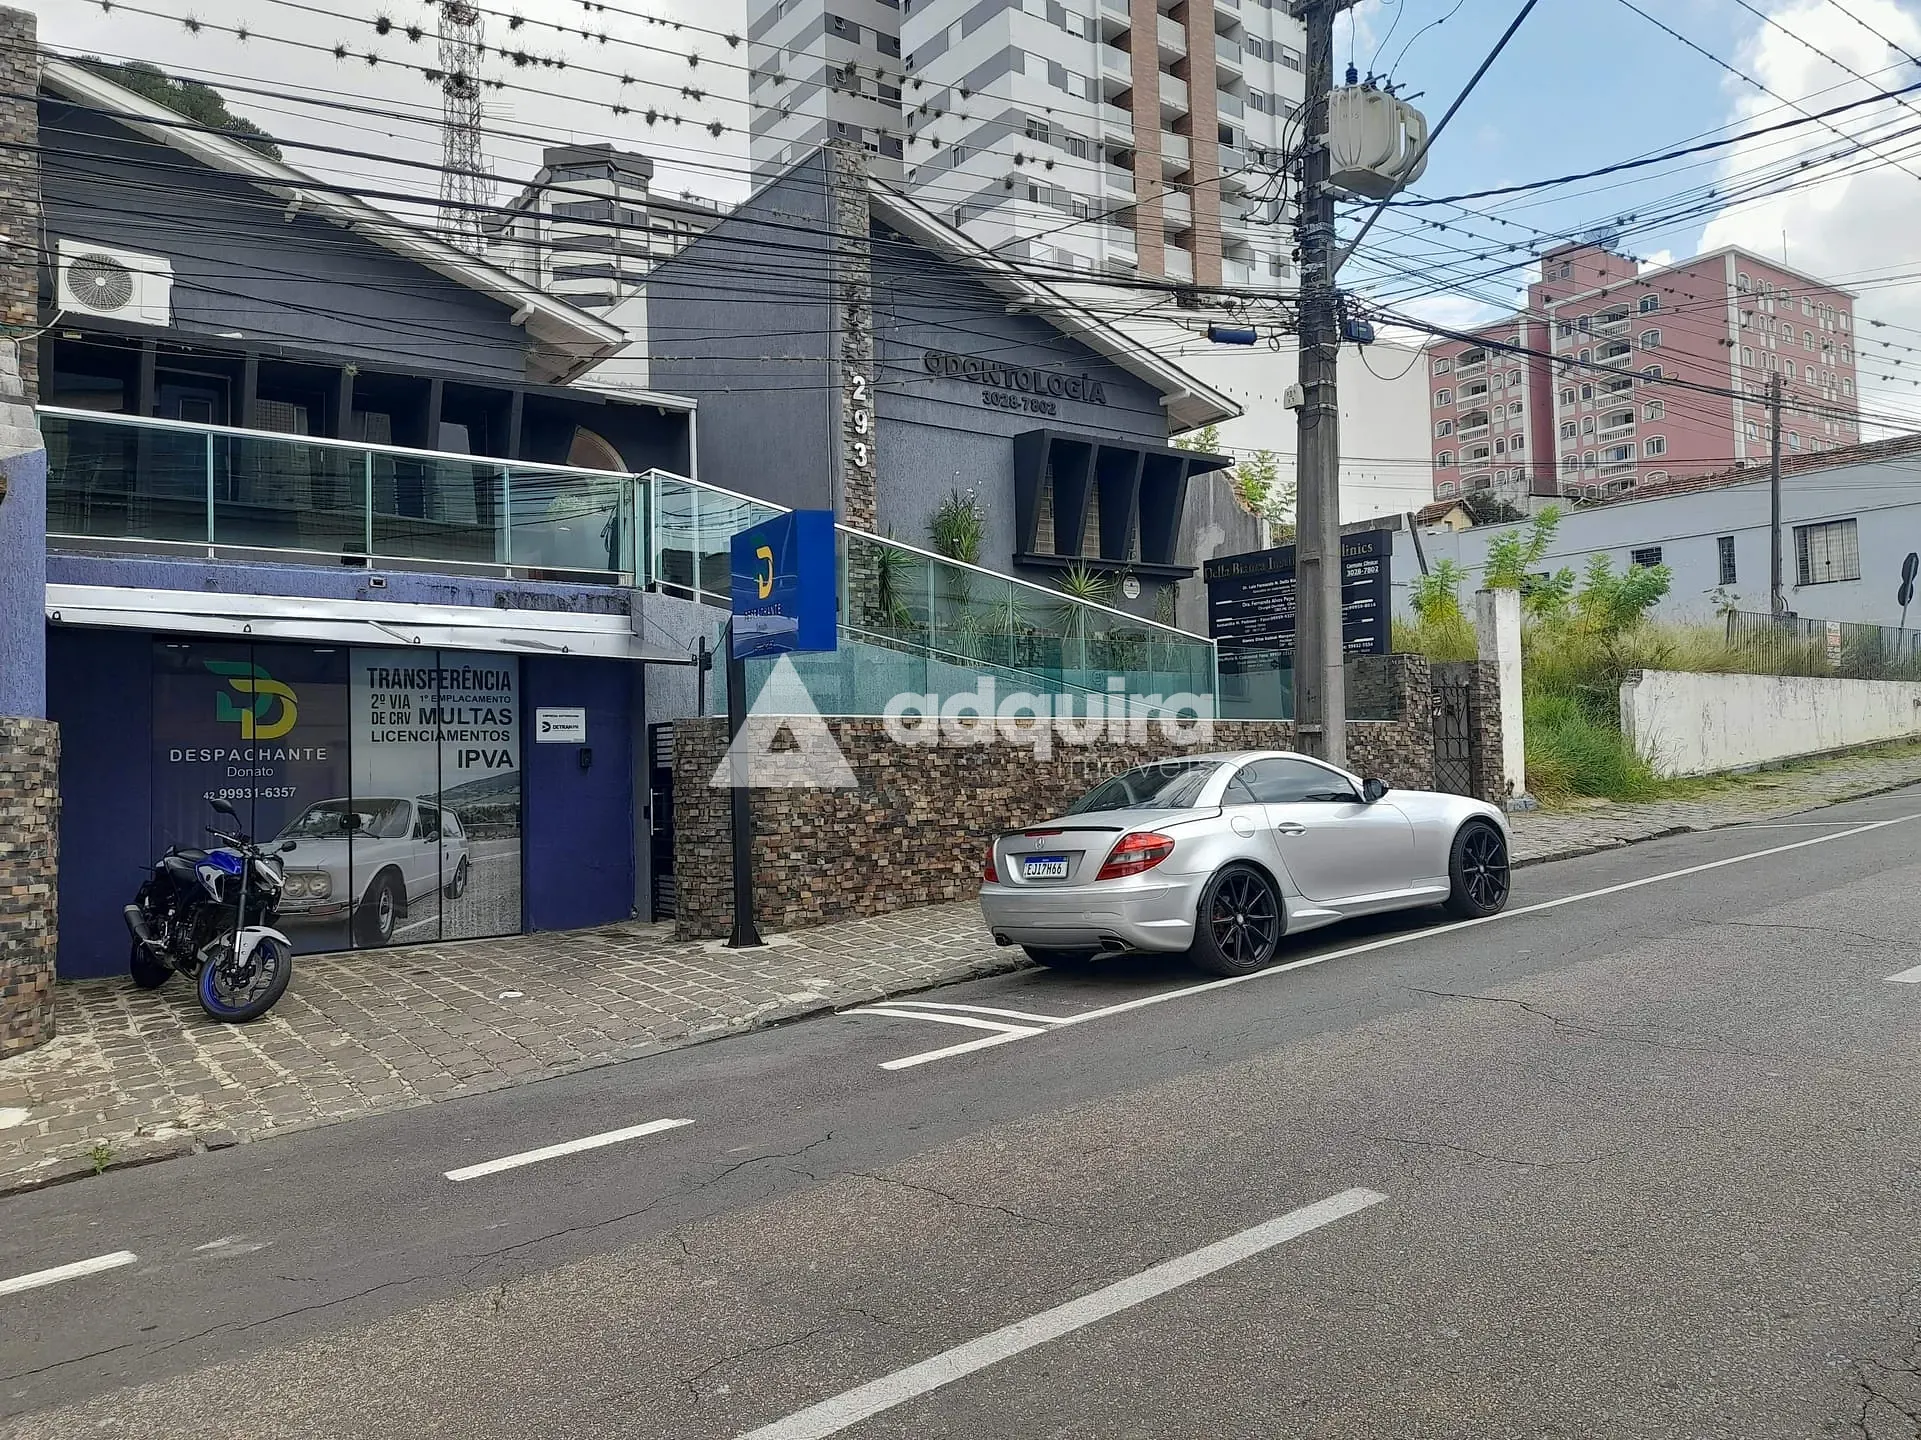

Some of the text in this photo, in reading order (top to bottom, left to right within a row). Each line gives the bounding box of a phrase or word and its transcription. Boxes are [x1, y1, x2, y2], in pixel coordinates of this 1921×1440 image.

[982, 391, 1056, 415] 3028-7802
[1342, 543, 1373, 557] linics
[367, 665, 511, 691] TRANSFERÊNCIA
[389, 694, 411, 709] VIA
[431, 694, 512, 704] EMPLACAMENTO
[371, 711, 411, 725] DE CRV
[419, 707, 513, 725] MULTAS
[371, 730, 510, 742] LICENCIAMENTOS
[170, 748, 328, 762] DESPACHANTE
[458, 750, 514, 769] IPVA
[227, 766, 274, 777] Donato
[219, 786, 296, 799] 99931-6357
